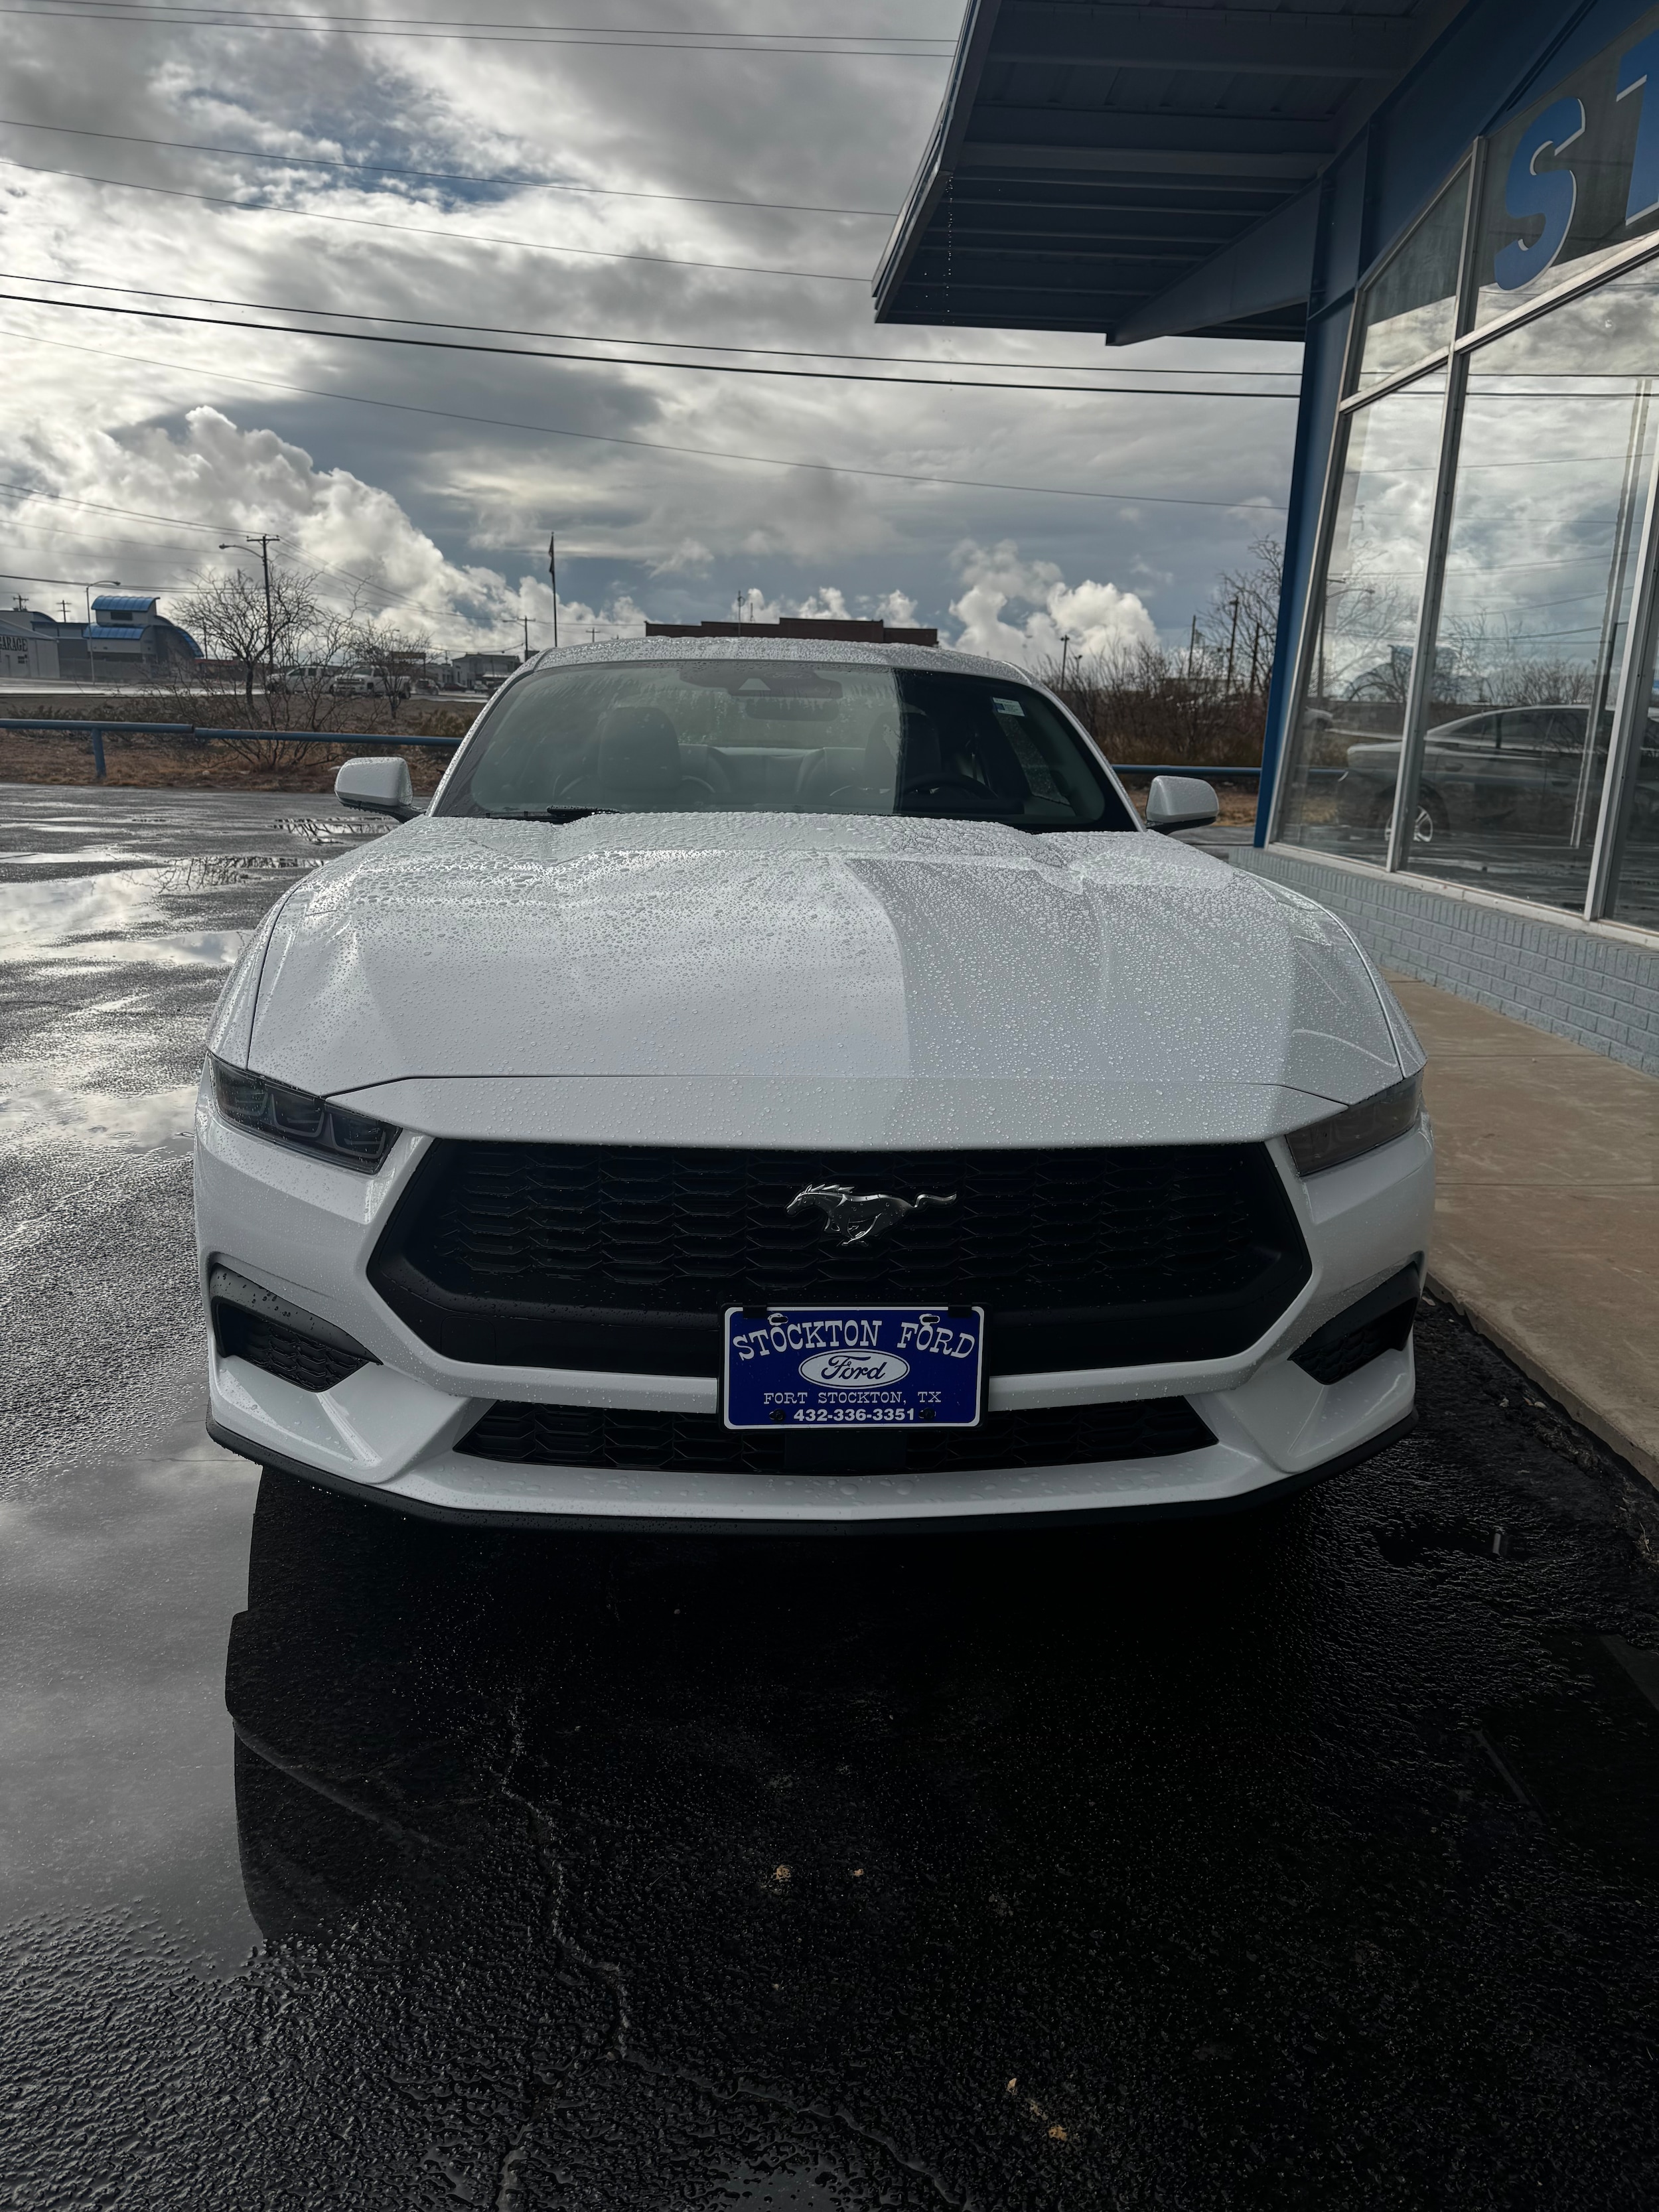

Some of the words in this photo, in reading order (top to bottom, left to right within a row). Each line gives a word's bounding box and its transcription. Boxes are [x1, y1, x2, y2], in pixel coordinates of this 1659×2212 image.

[772, 671, 803, 680] Ford
[733, 1320, 883, 1361] STOCKTON
[897, 1321, 975, 1359] FORD
[821, 1355, 887, 1380] Ford
[763, 1392, 808, 1404] FORT
[818, 1391, 906, 1405] STOCKTON,
[917, 1391, 942, 1403] TX
[793, 1408, 914, 1422] 432-336-3351
